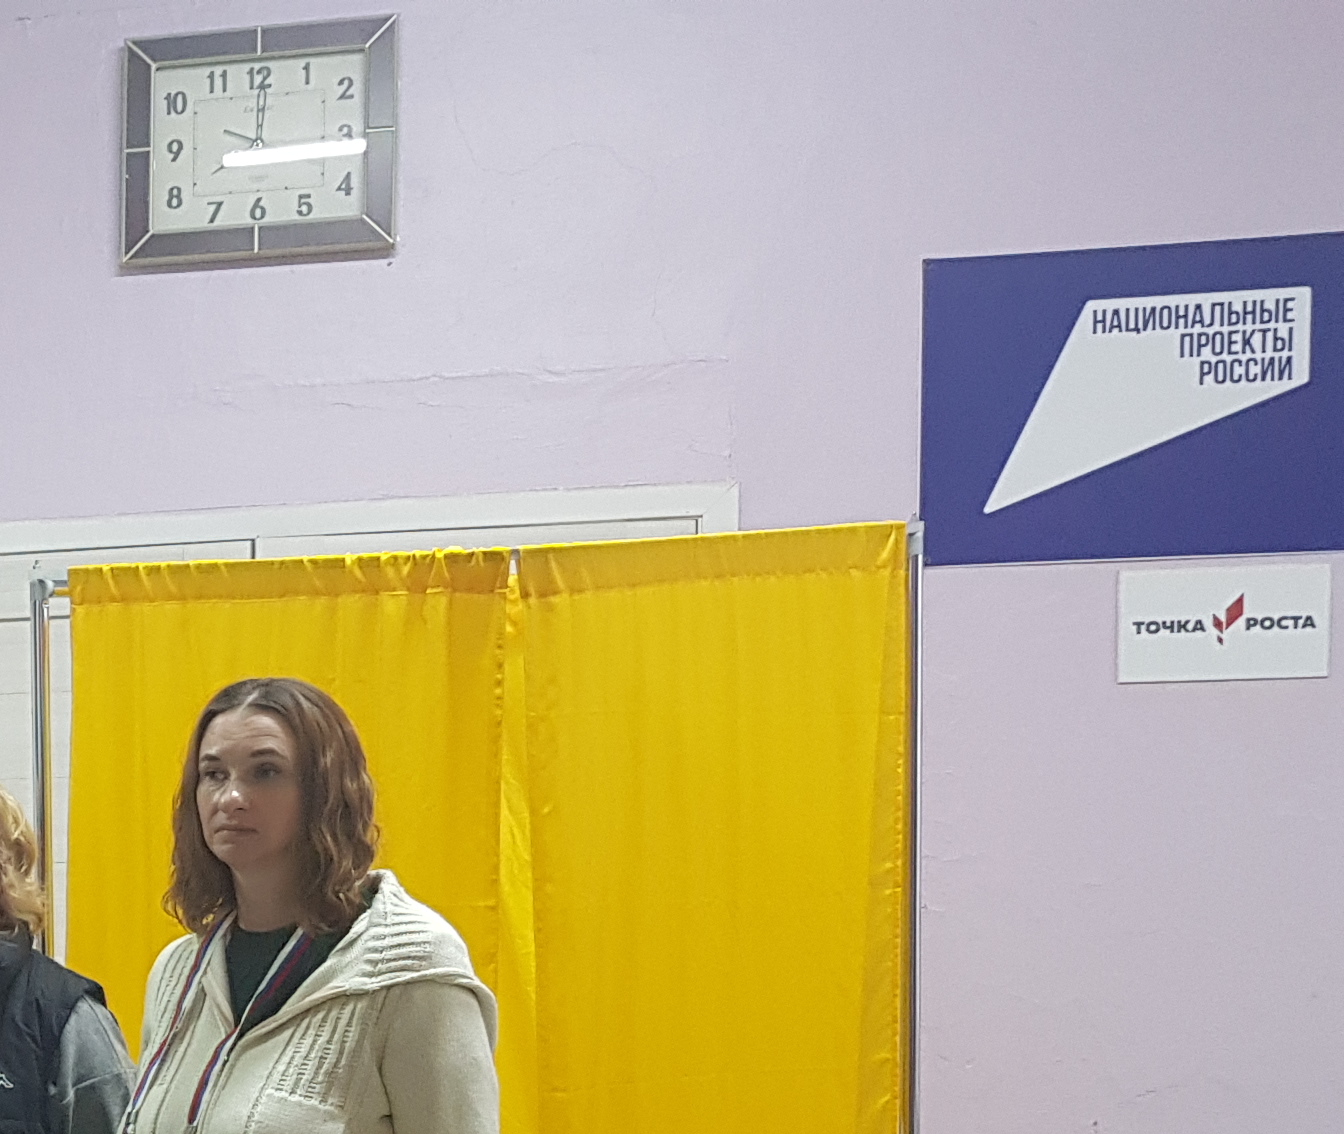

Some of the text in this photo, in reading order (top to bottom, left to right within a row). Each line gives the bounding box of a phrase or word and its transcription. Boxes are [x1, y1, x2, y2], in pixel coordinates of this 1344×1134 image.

[207, 70, 228, 93] 11
[247, 66, 272, 90] 12
[302, 62, 311, 85] 1
[337, 76, 354, 100] 2
[164, 91, 187, 115] 10
[167, 139, 184, 162] 9
[336, 172, 354, 196] 4
[166, 186, 183, 209] 8
[249, 197, 266, 220] 6
[296, 194, 312, 217] 5
[207, 201, 224, 224] 7
[1092, 297, 1296, 334] НАЦИОНАЛЬНЫЕ
[1180, 327, 1294, 358] ПРОЕКТЫ
[1199, 356, 1293, 385] РОССИИ
[1132, 615, 1316, 635] ТОЧКА РОСТА
